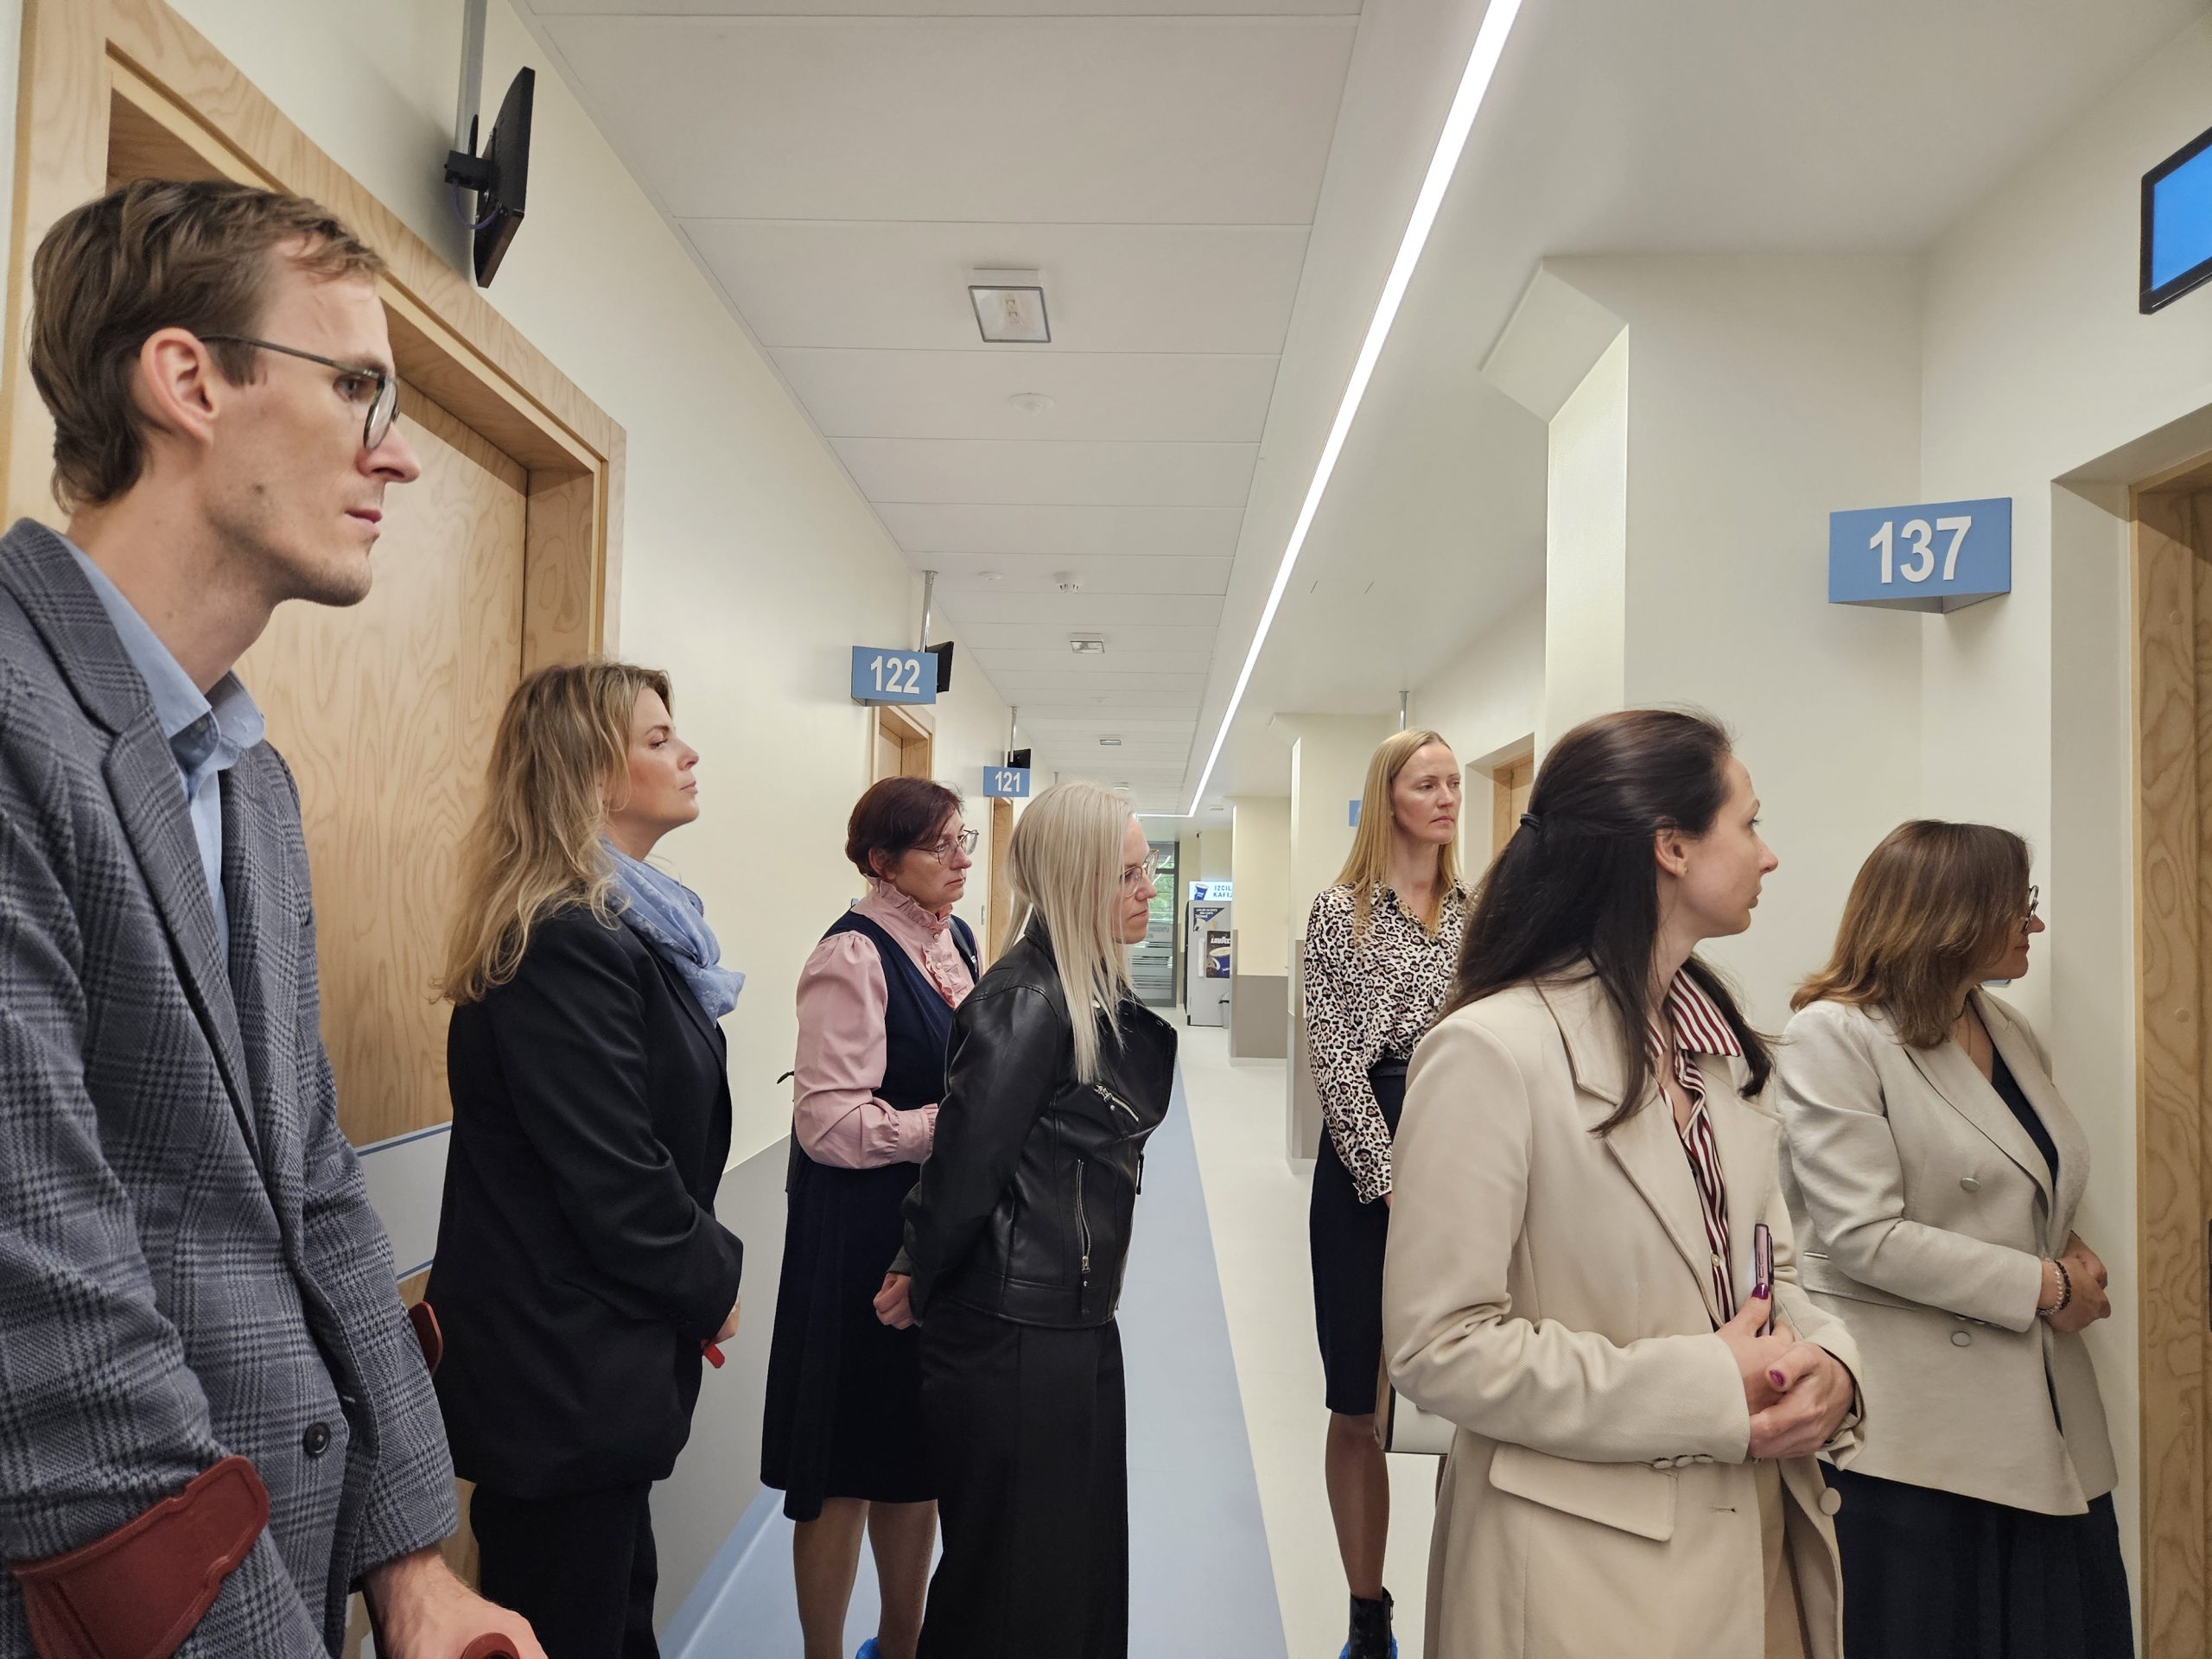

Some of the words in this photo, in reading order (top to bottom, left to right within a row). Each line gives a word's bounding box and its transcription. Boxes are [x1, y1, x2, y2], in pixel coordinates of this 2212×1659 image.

[1869, 516, 1972, 584] 137
[870, 655, 920, 695] 122
[995, 771, 1021, 793] 121
